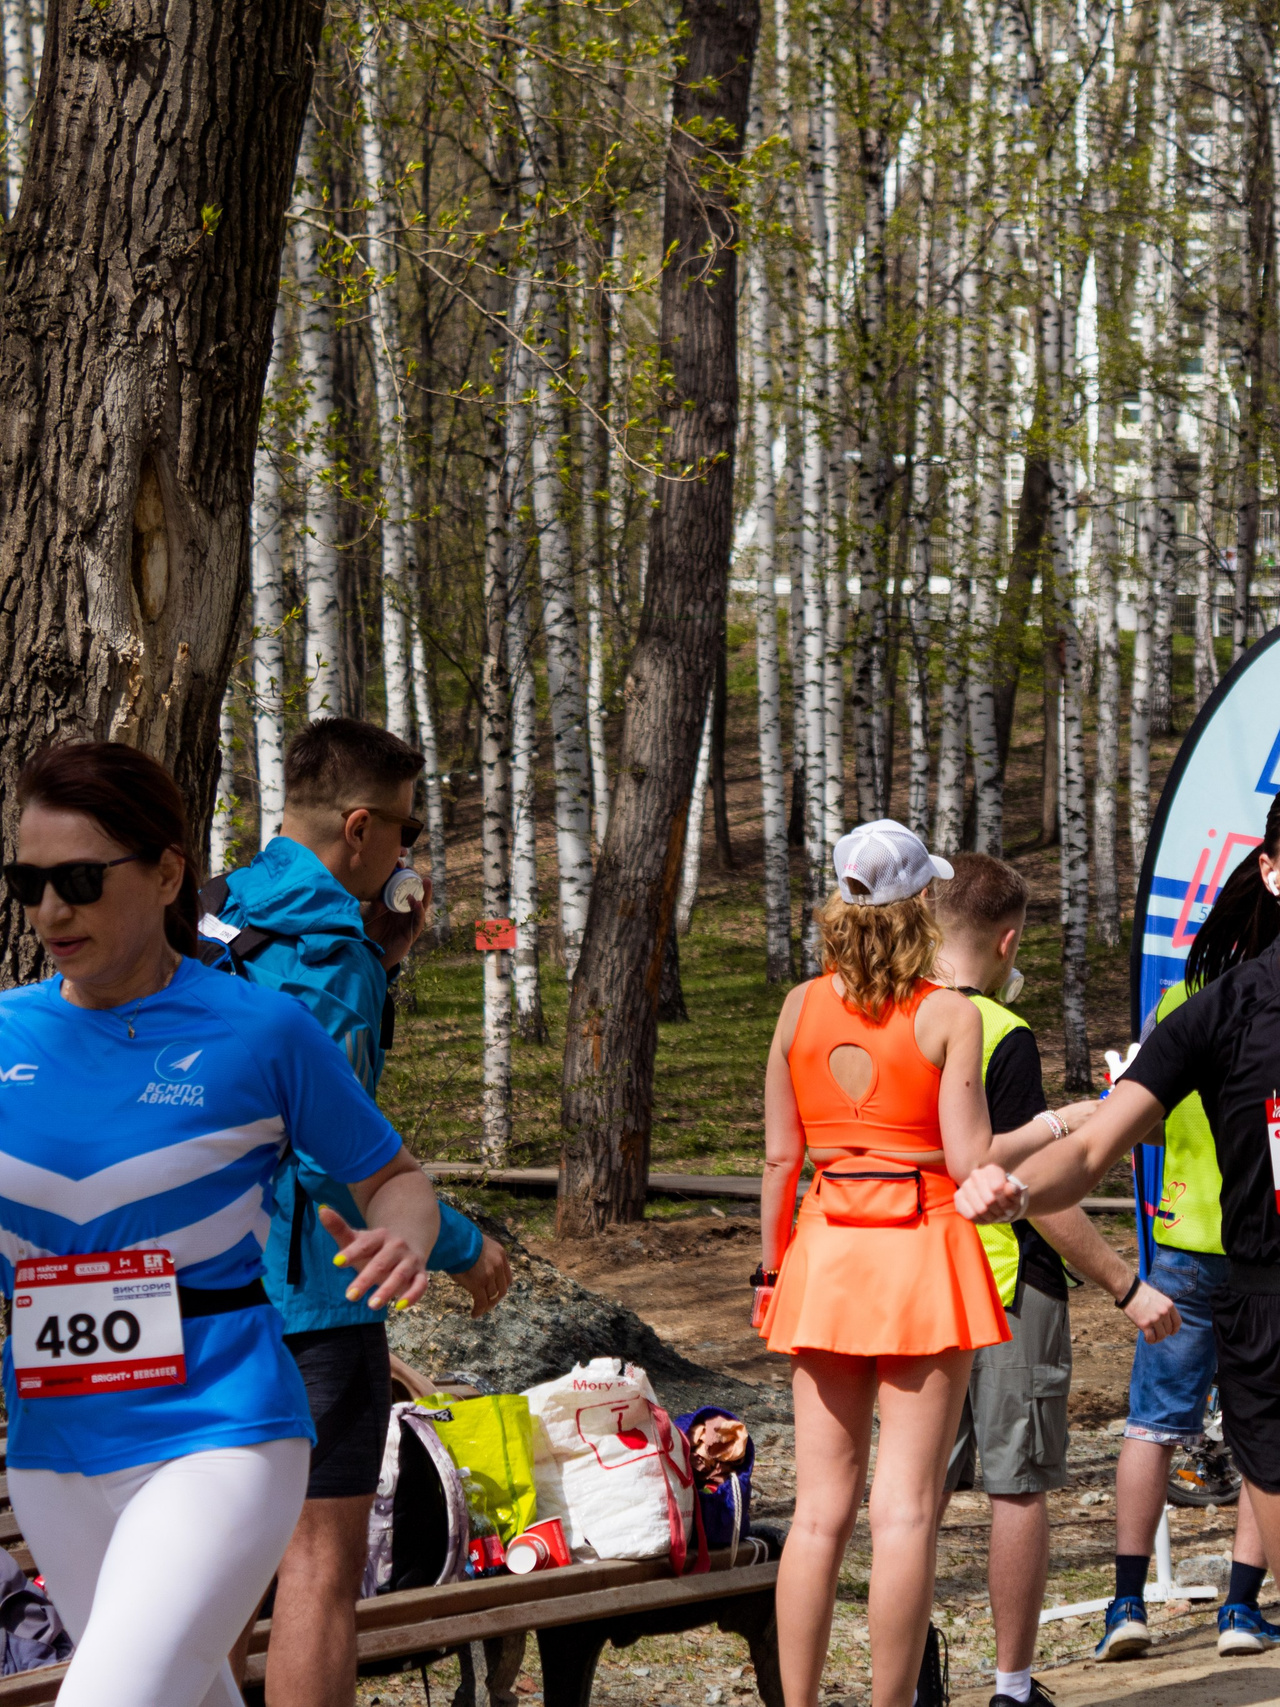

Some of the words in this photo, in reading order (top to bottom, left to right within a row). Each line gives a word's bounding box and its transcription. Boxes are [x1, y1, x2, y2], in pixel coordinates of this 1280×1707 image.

[145, 1082, 204, 1096] ВСМПО
[137, 1092, 204, 1107] АВИСМА
[112, 1282, 171, 1295] ВИКТОРИЯ
[35, 1310, 141, 1358] 480
